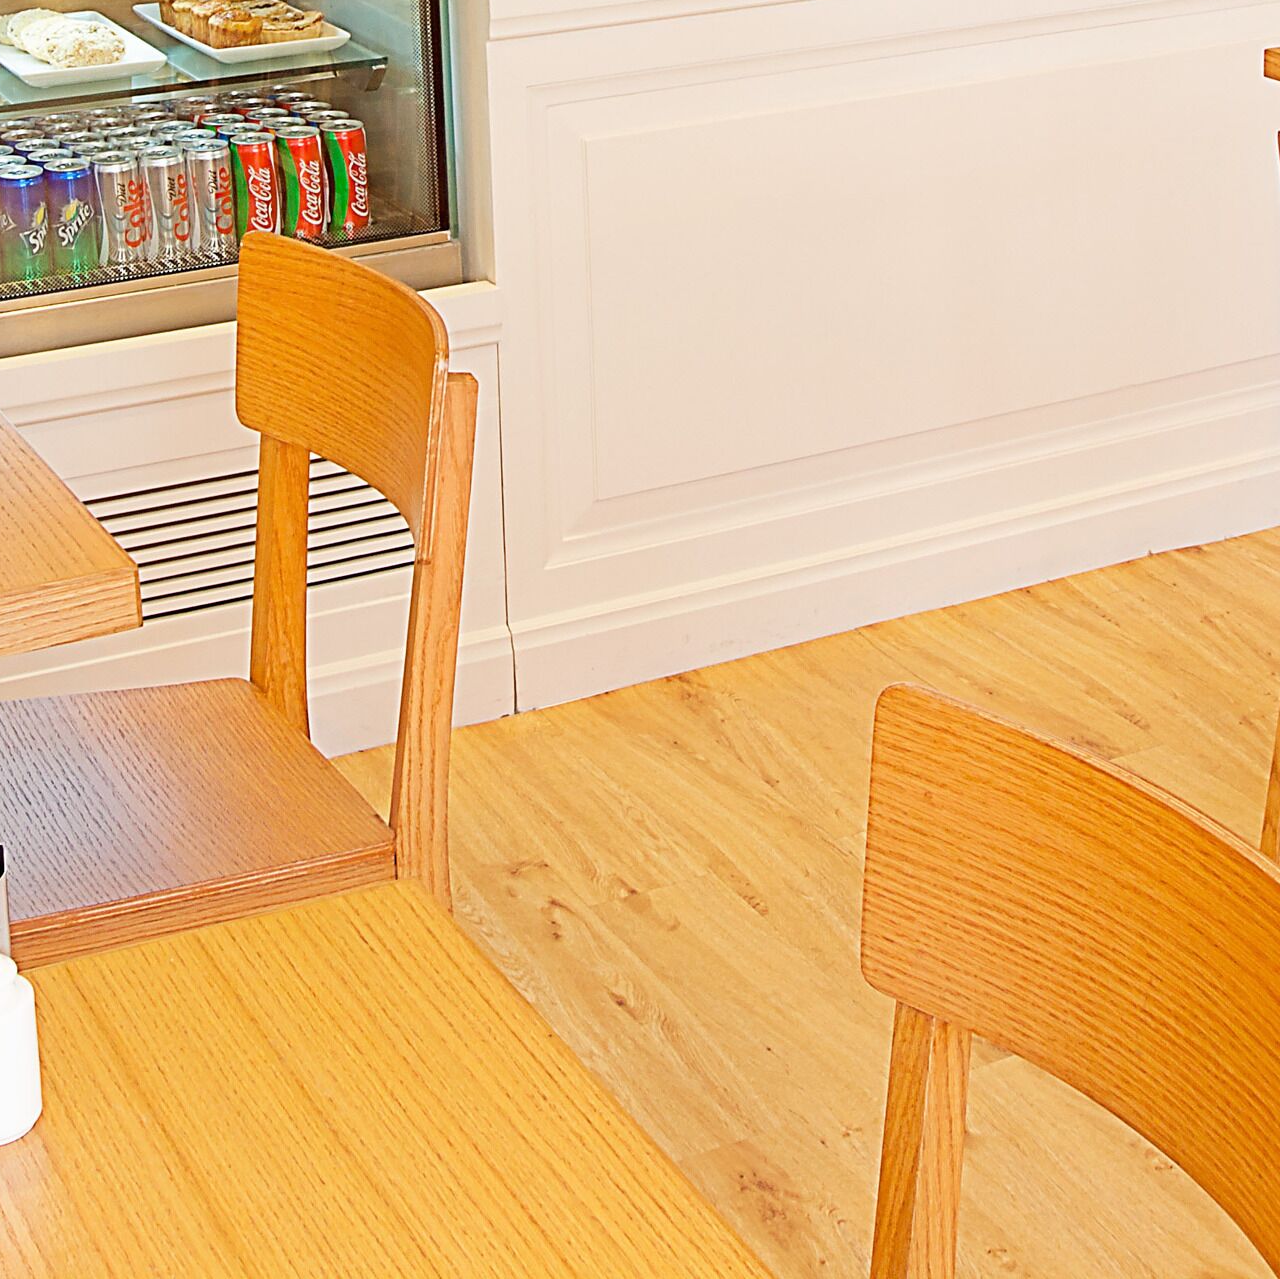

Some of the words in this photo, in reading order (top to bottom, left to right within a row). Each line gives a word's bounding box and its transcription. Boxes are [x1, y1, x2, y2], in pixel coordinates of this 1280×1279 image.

[58, 203, 90, 247] Sprite
[123, 179, 144, 248] Coke
[171, 174, 190, 241] Coke
[215, 167, 233, 235] Coke
